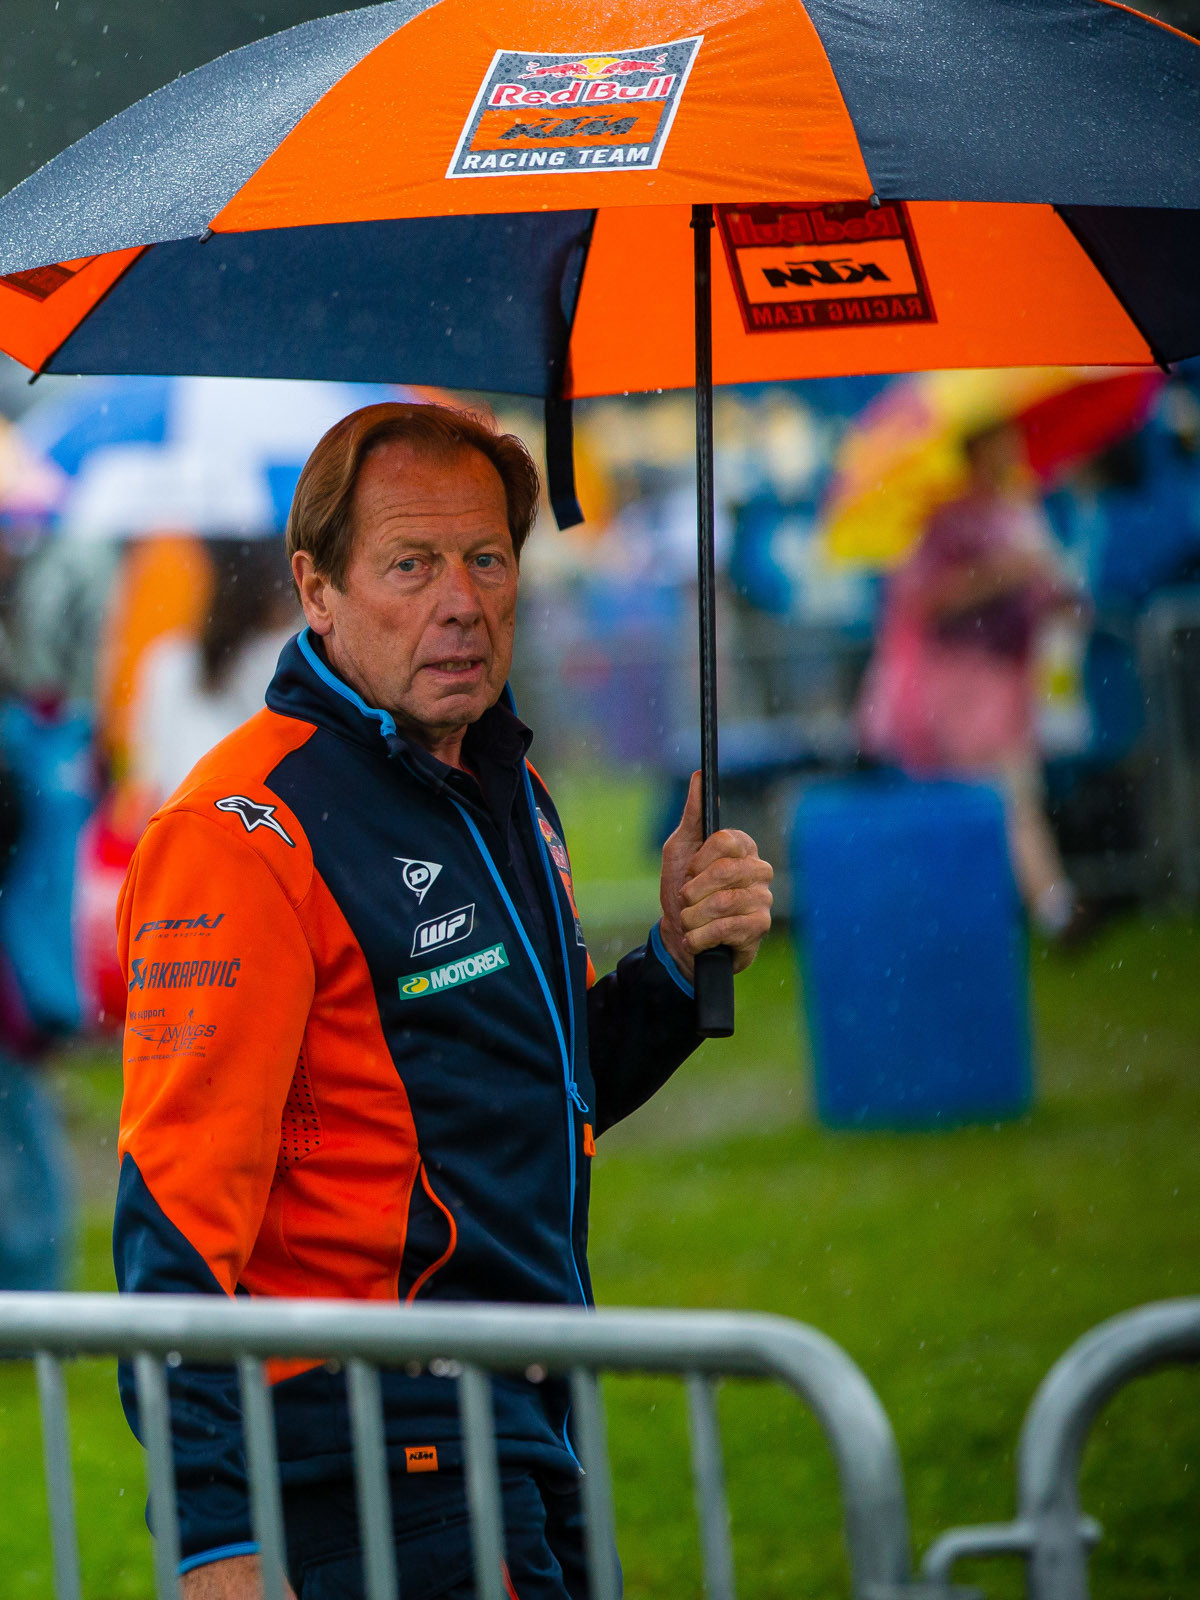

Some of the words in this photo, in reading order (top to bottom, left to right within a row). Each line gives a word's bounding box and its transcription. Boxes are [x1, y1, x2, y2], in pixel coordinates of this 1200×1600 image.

[489, 81, 581, 106] Red
[582, 75, 676, 102] Bull
[498, 114, 640, 140] KTM
[462, 151, 565, 170] RACING
[578, 147, 650, 165] TEAM
[134, 913, 226, 942] pankl
[421, 913, 466, 949] WP
[430, 946, 506, 990] MOTOREX
[138, 1008, 165, 1020] support
[167, 1022, 217, 1038] WINGS
[409, 1452, 433, 1461] KTM
